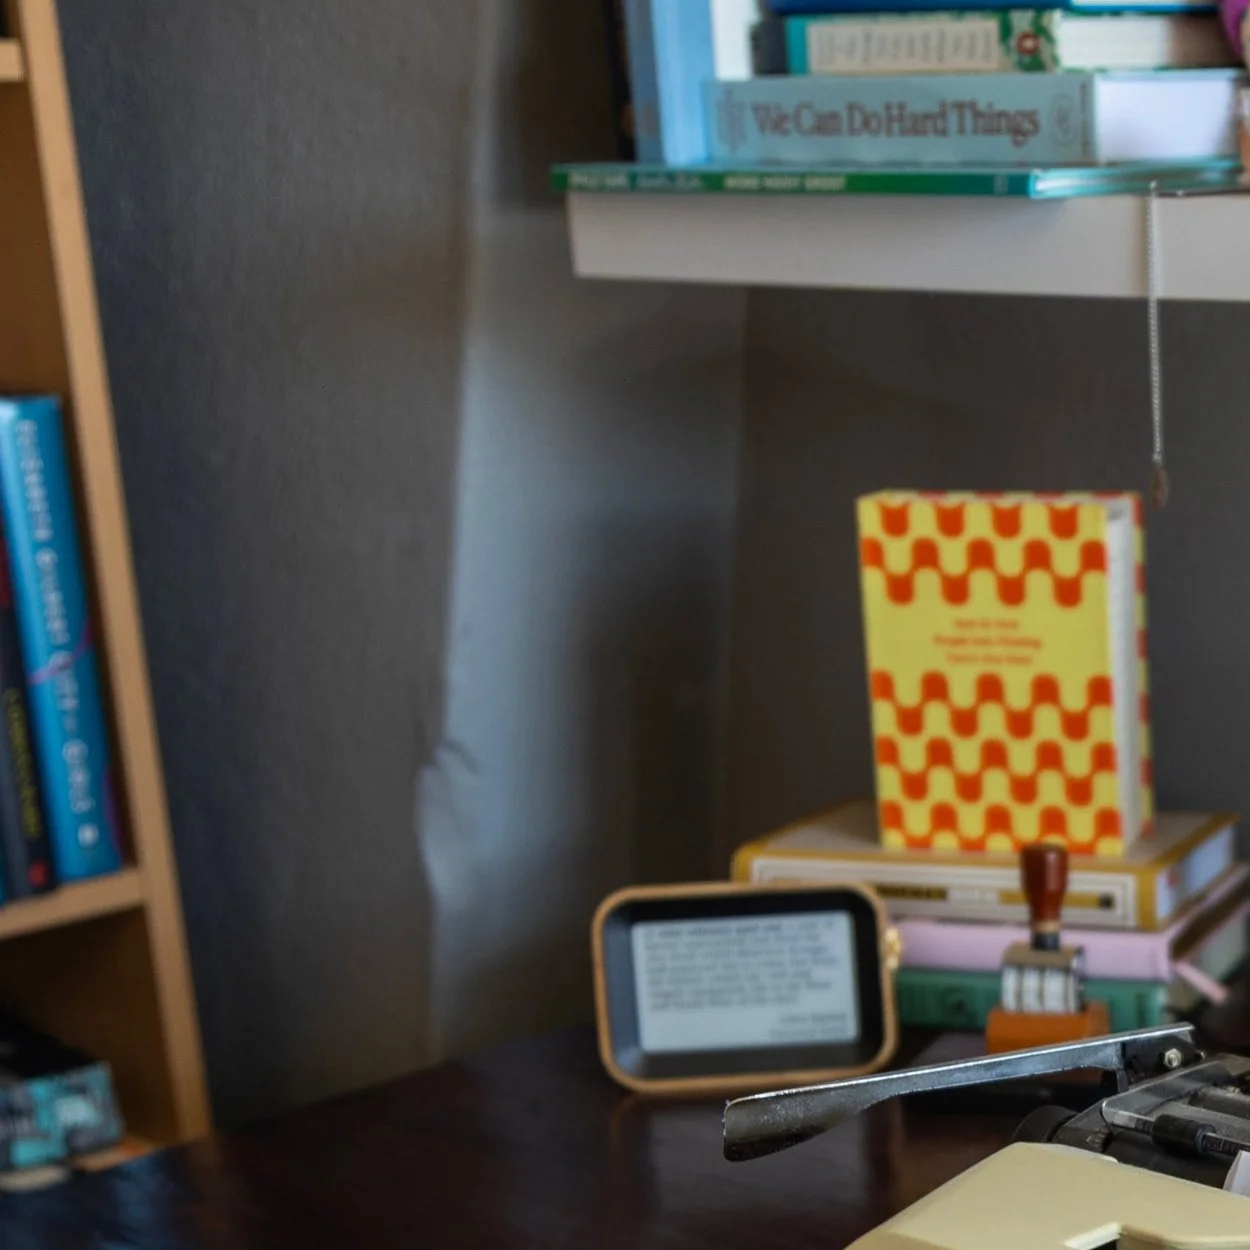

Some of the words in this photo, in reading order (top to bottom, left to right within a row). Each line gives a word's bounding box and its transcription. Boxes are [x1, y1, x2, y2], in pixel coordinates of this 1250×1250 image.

[751, 103, 790, 136] We
[794, 103, 842, 137] Can
[847, 104, 883, 137] Do
[885, 103, 948, 138] Hard
[953, 103, 1040, 148] Things
